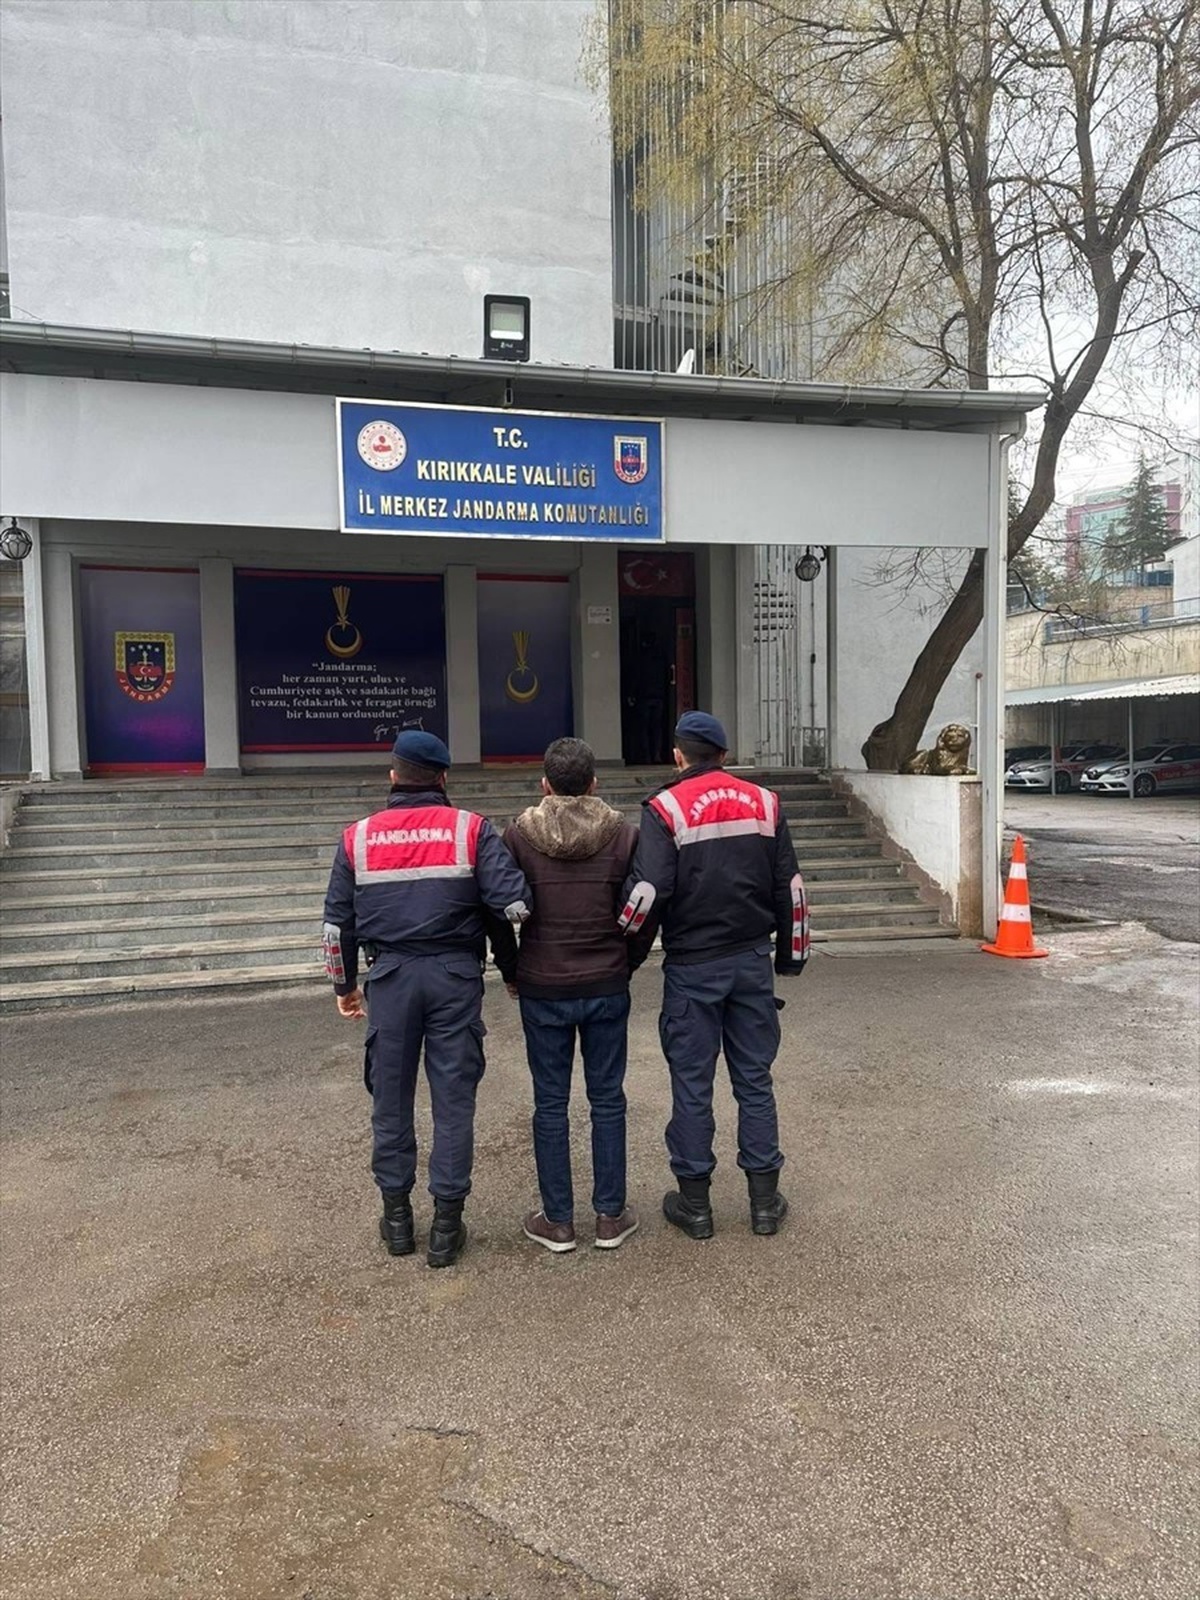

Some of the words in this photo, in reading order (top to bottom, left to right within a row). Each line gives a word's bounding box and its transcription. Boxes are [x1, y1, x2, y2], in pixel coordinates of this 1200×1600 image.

[493, 427, 528, 449] T.C.
[416, 459, 517, 485] KIRIKKALE
[522, 462, 597, 488] VALİLİĞİ
[358, 488, 375, 515] İL
[380, 495, 448, 518] MERKEZ
[452, 498, 540, 523] JANDARMA
[543, 501, 650, 526] KOMUTANLIĞI
[119, 678, 173, 701] JANDARMA
[282, 674, 300, 683] her
[303, 675, 339, 683] zaman
[342, 675, 367, 686] yurt,
[370, 674, 392, 683] ulus
[249, 686, 322, 698] Cumhuriyete
[324, 686, 343, 697] aşk
[345, 688, 357, 696] ve
[360, 686, 408, 696] sadakatle
[411, 687, 437, 698] bağlı
[250, 699, 290, 709] tevazu,
[292, 698, 348, 707] fedakarlık
[351, 699, 362, 707] ve
[365, 698, 402, 709] feragat
[404, 698, 437, 709] örneği
[286, 709, 303, 719] bir
[305, 709, 340, 719] kanun
[690, 788, 758, 820] JANDARMA
[367, 828, 453, 846] JANDARMA
